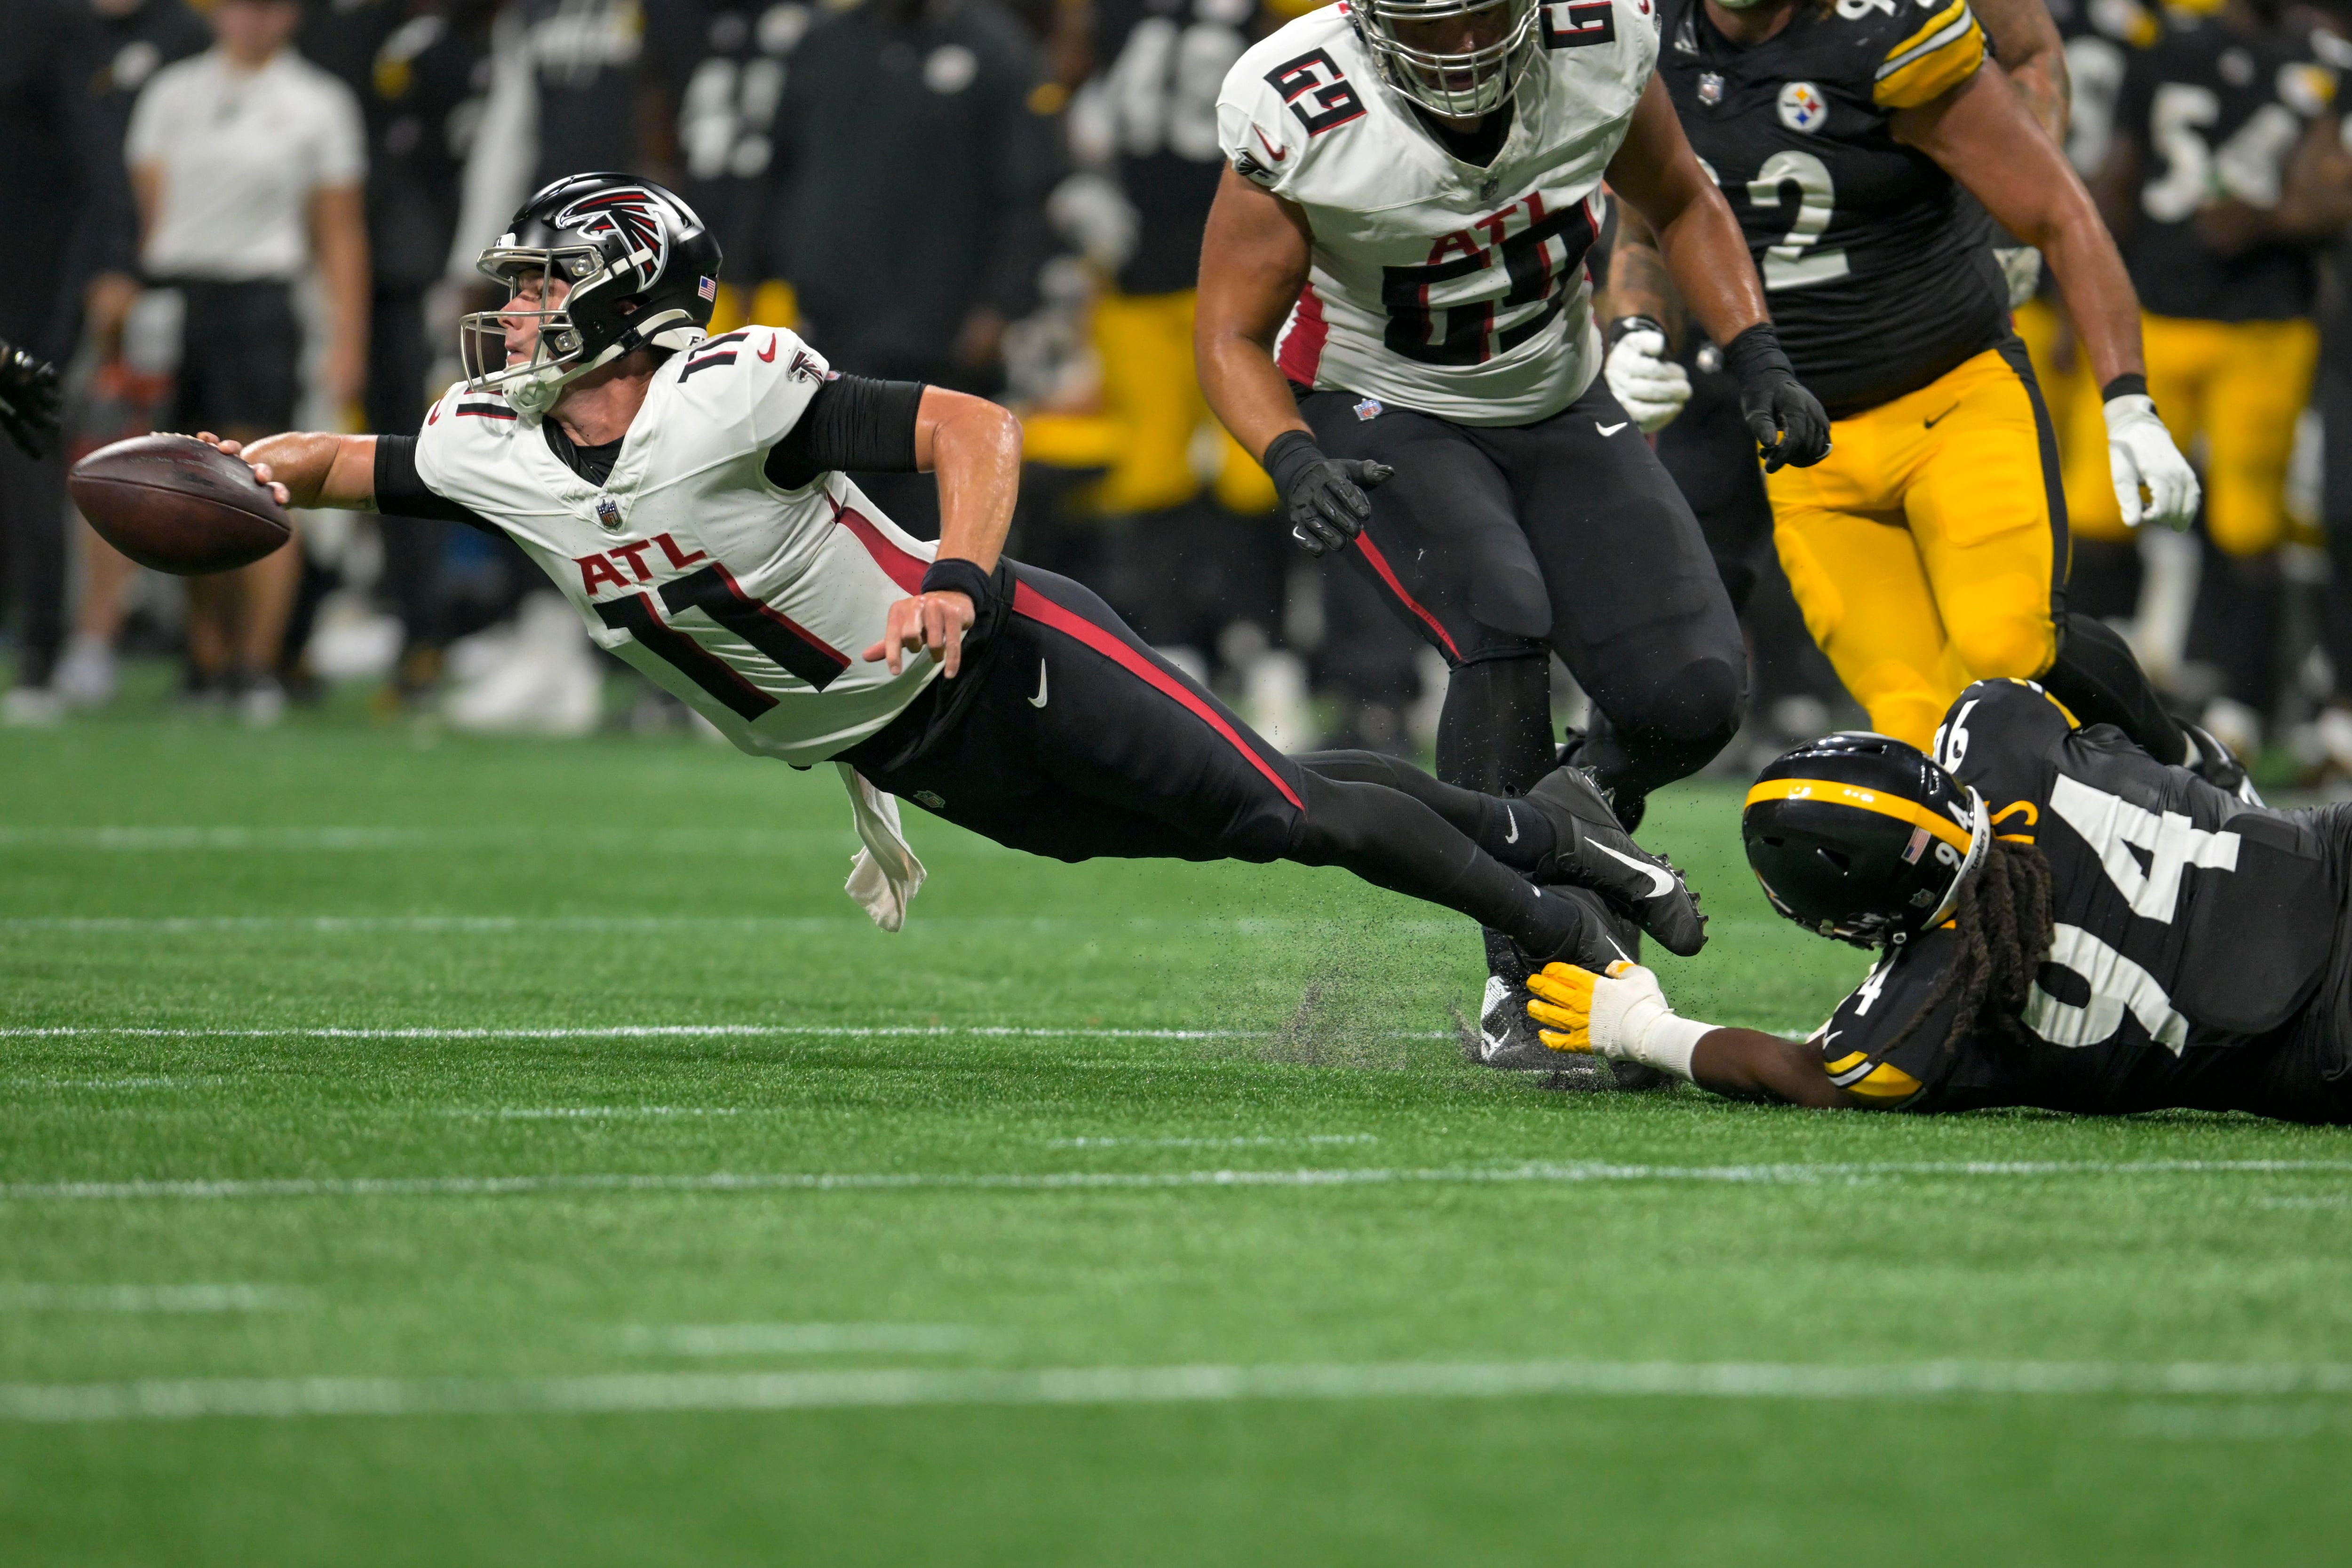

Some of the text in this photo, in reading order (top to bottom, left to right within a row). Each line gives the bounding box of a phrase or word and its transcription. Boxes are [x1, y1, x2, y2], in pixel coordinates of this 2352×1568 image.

[1263, 47, 1368, 137] 69
[677, 332, 751, 383] 11
[572, 532, 707, 596] ATL
[593, 562, 852, 722] 11
[2020, 773, 2241, 1058] 94
